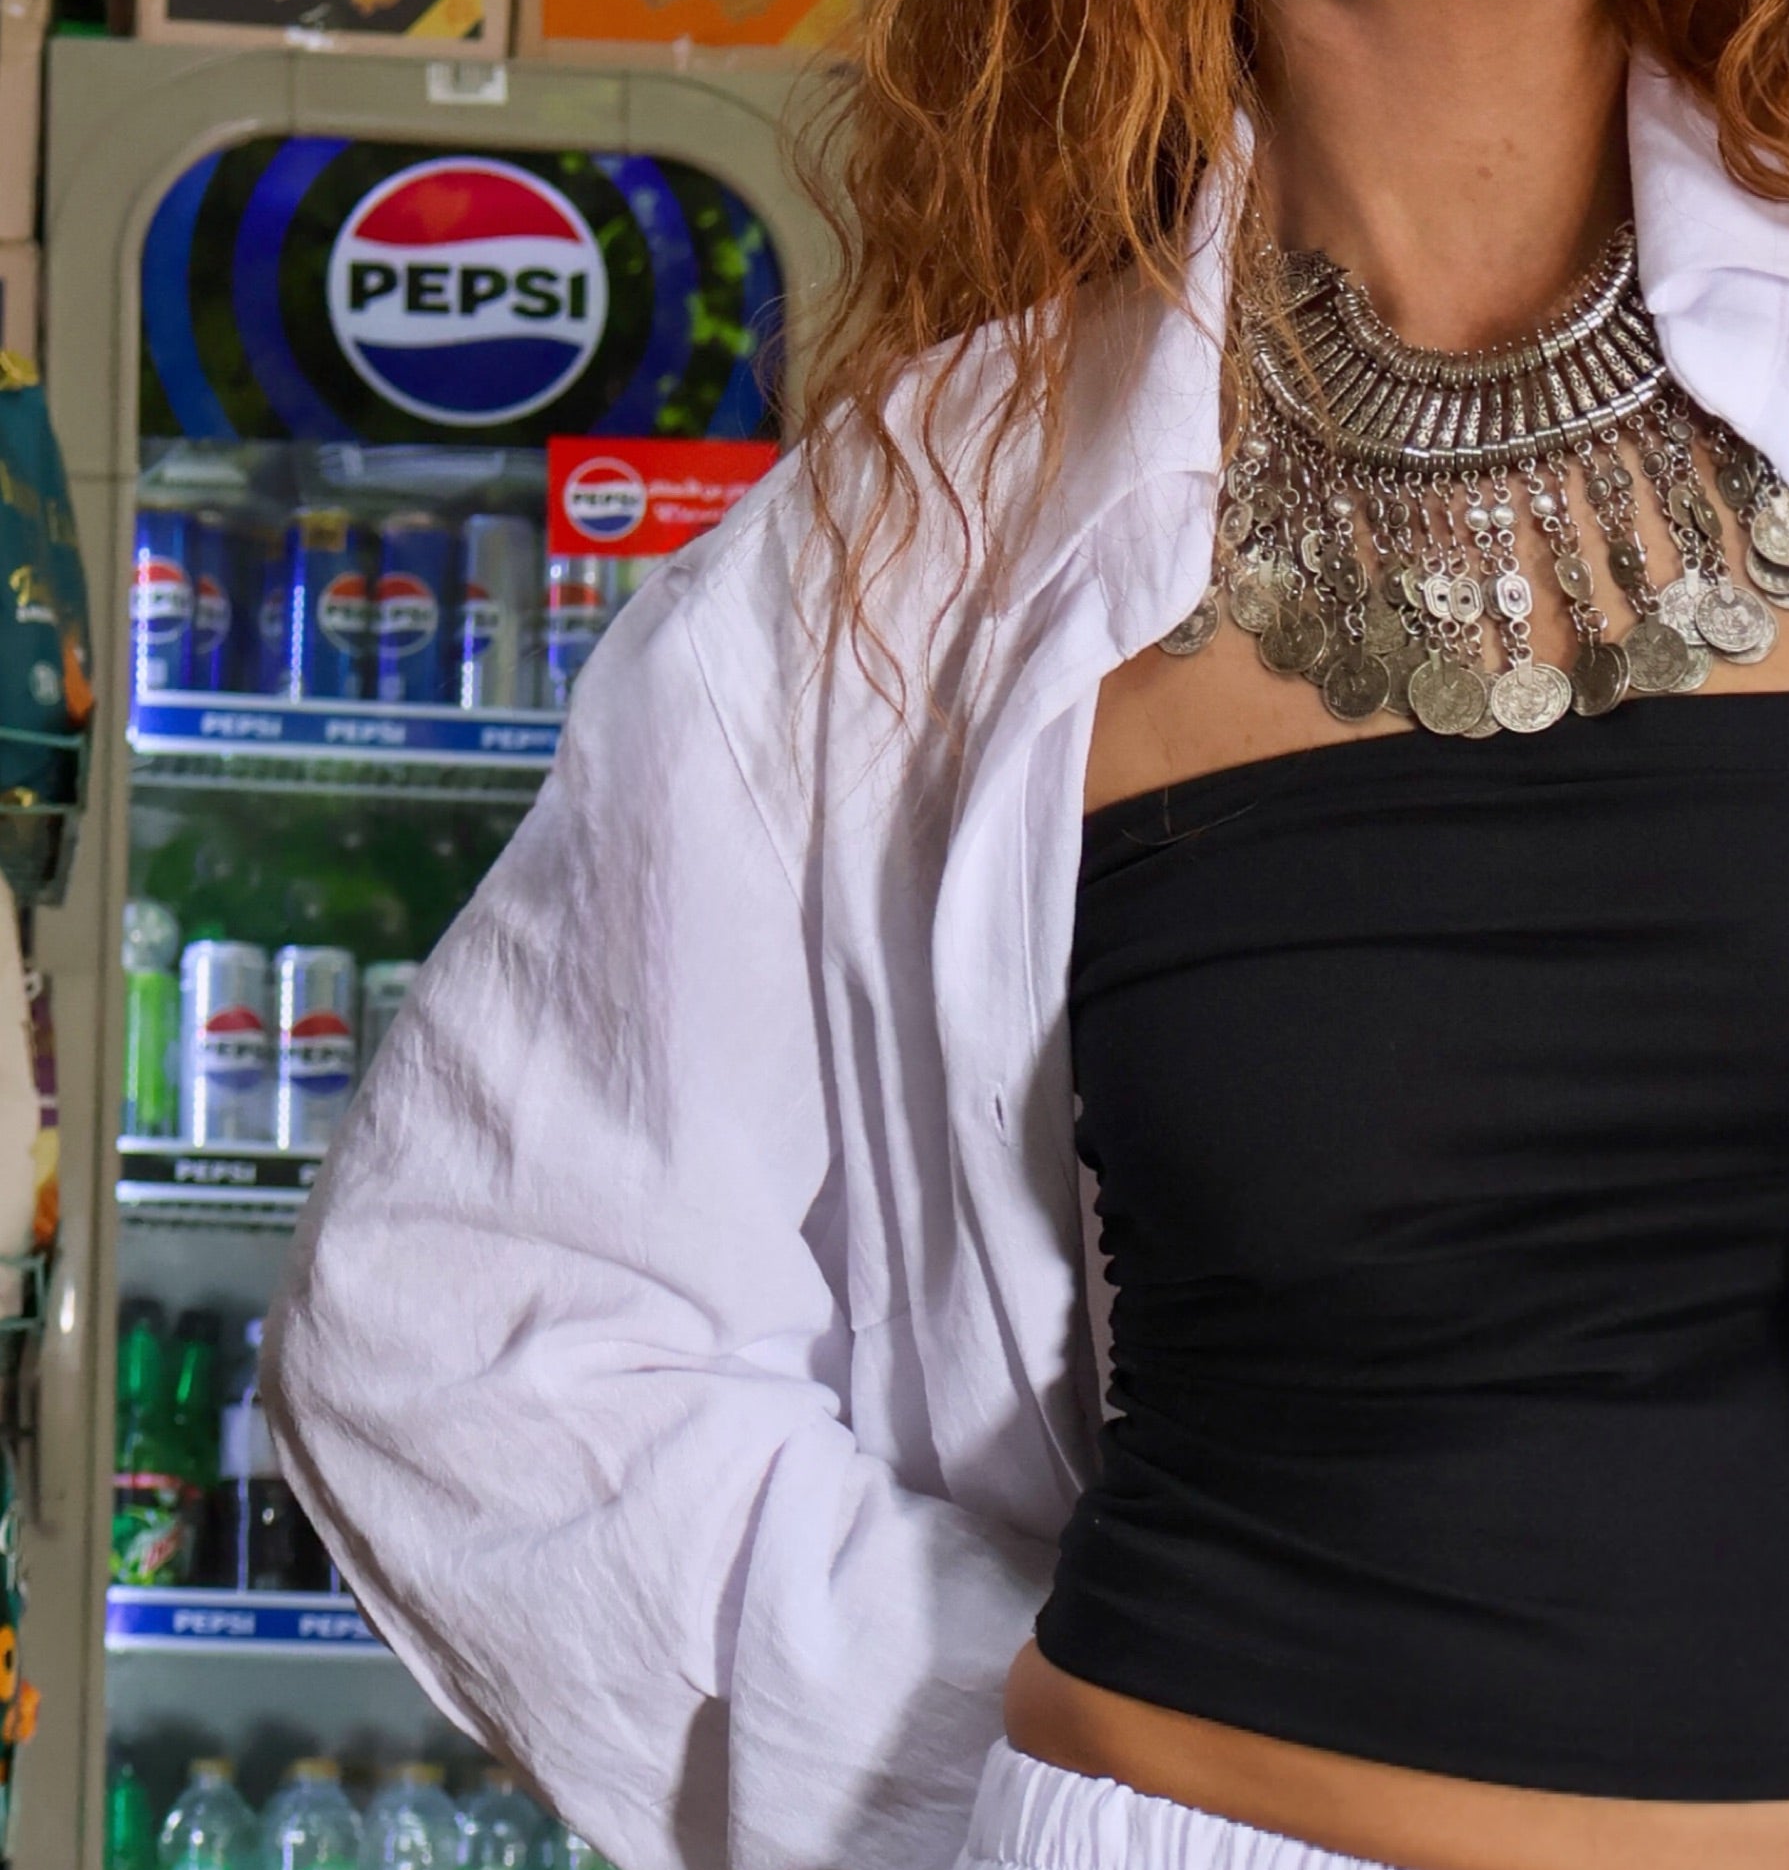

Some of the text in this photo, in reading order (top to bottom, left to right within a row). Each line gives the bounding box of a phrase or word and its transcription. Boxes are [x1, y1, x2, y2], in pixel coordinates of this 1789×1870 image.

[348, 260, 588, 321] PEPSI
[202, 713, 282, 738] PEPSI
[326, 720, 405, 745] PEPSI
[175, 1160, 257, 1184] PEPSI
[173, 1610, 255, 1637] PEPSI
